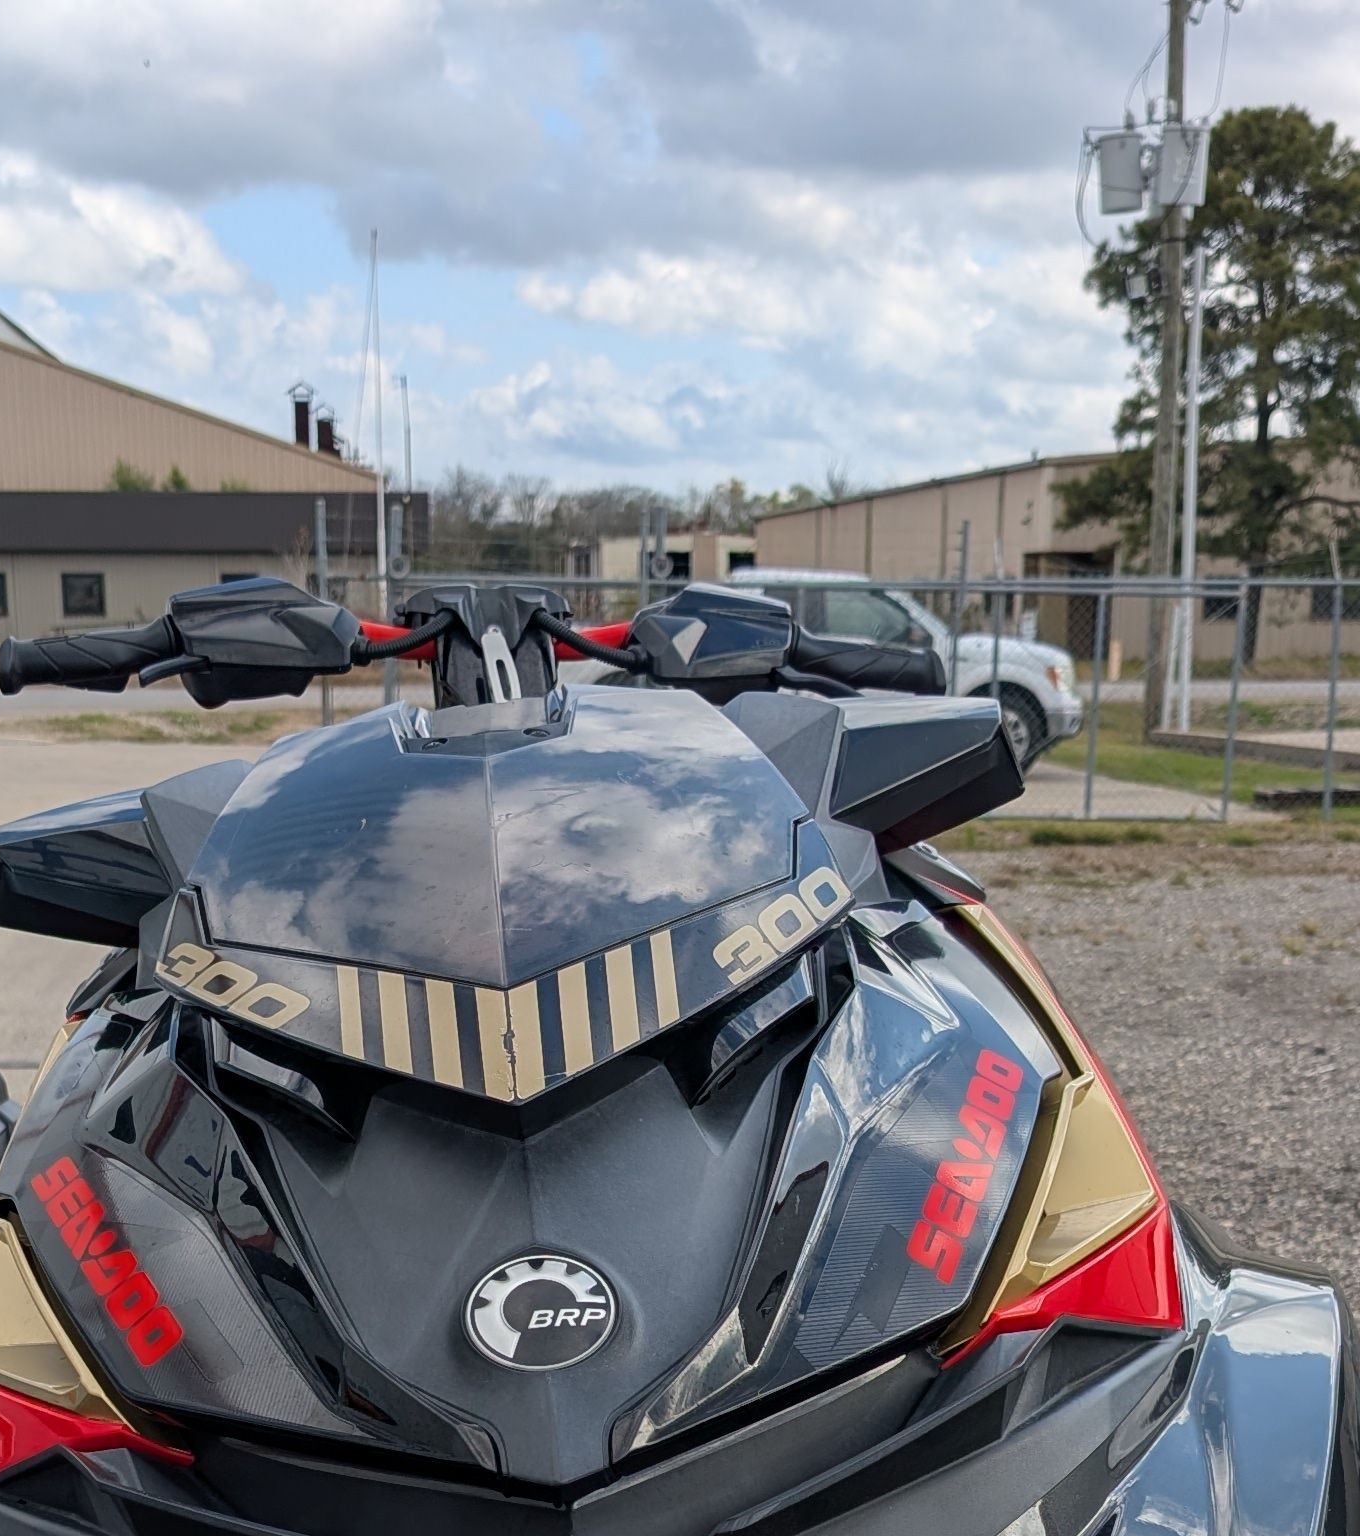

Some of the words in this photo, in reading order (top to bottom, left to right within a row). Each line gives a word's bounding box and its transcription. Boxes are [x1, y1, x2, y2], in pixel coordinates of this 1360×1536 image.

[711, 865, 852, 986] 300
[154, 942, 311, 1031] 300
[527, 1307, 607, 1330] BRP
